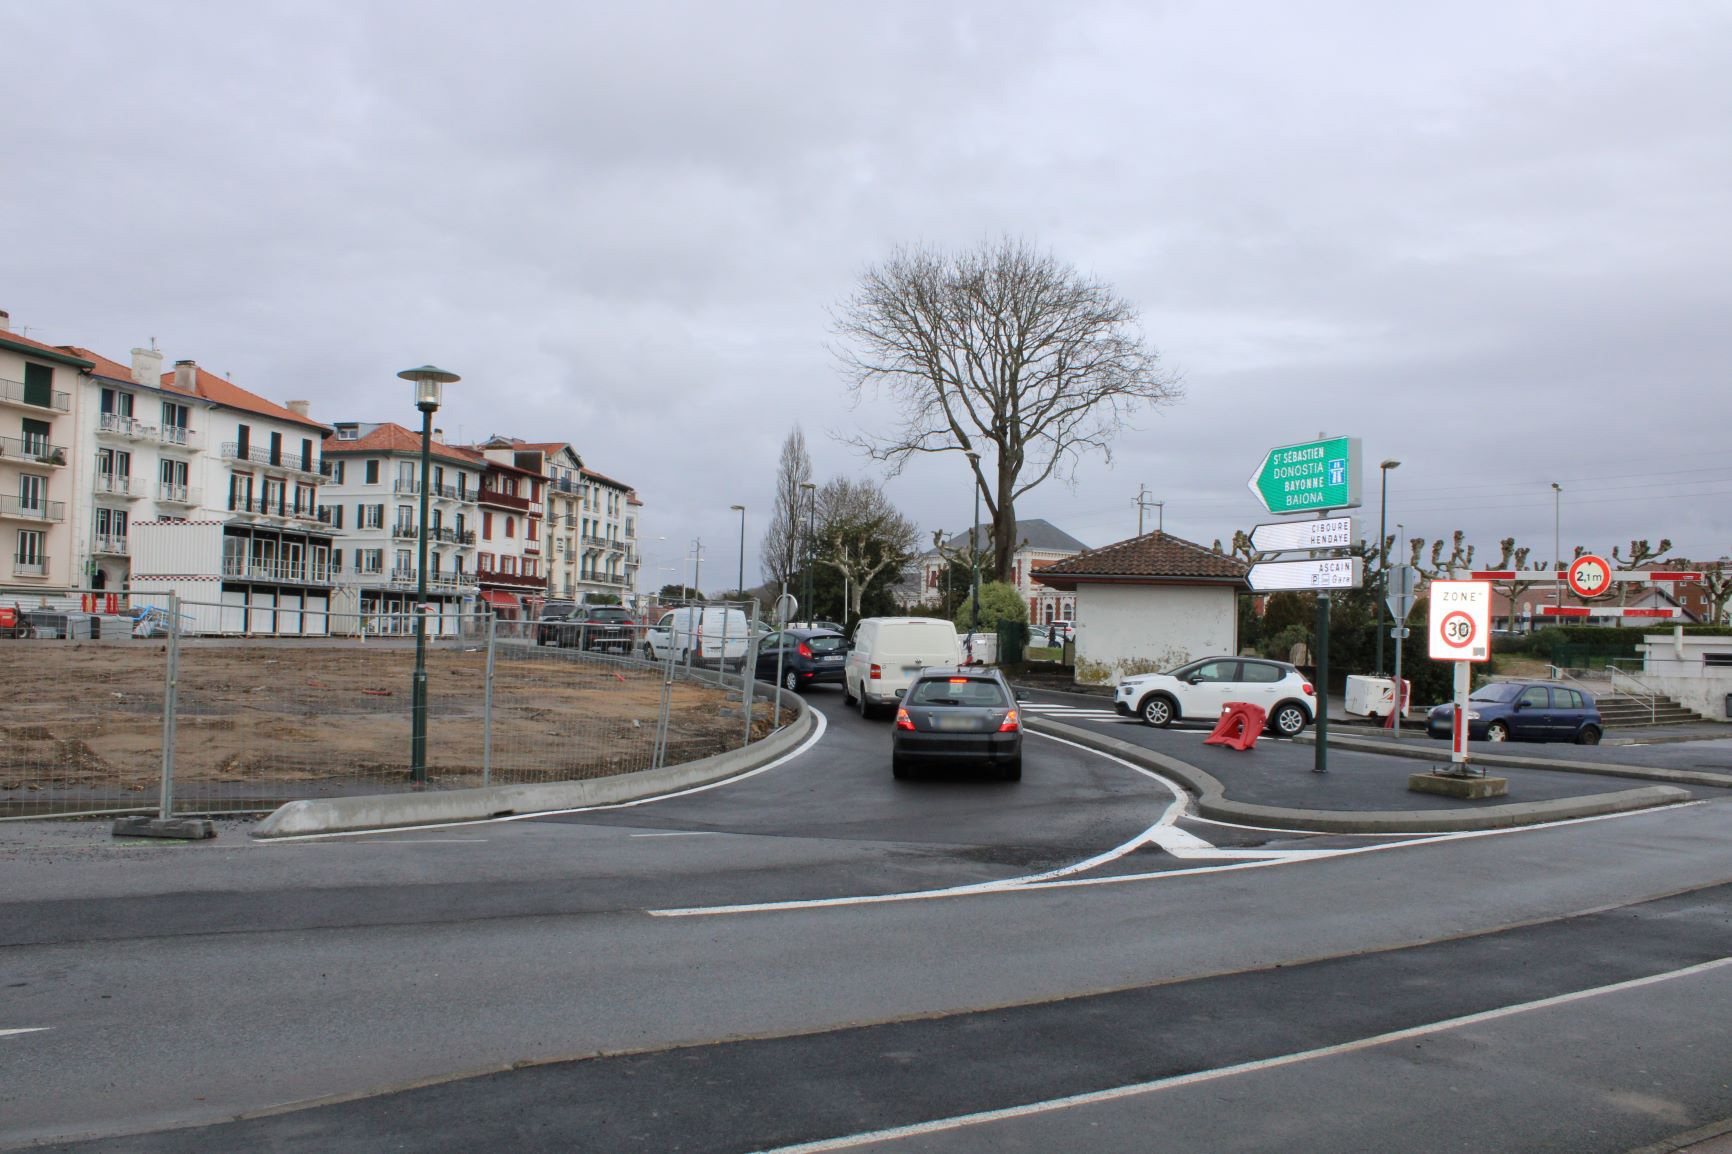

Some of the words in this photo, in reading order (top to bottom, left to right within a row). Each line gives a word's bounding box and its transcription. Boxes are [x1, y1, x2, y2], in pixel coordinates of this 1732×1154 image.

[1273, 462, 1324, 478] DONOSTIA
[1284, 477, 1324, 491] BAYONNE
[1286, 491, 1324, 505] BAIONA
[1311, 521, 1348, 533] CIBOURE
[1310, 533, 1348, 544] HENDAYE
[1319, 562, 1350, 573] ASCAIN
[1332, 574, 1350, 584] Gare
[1443, 591, 1477, 601] ZONE
[1448, 622, 1469, 638] 30
